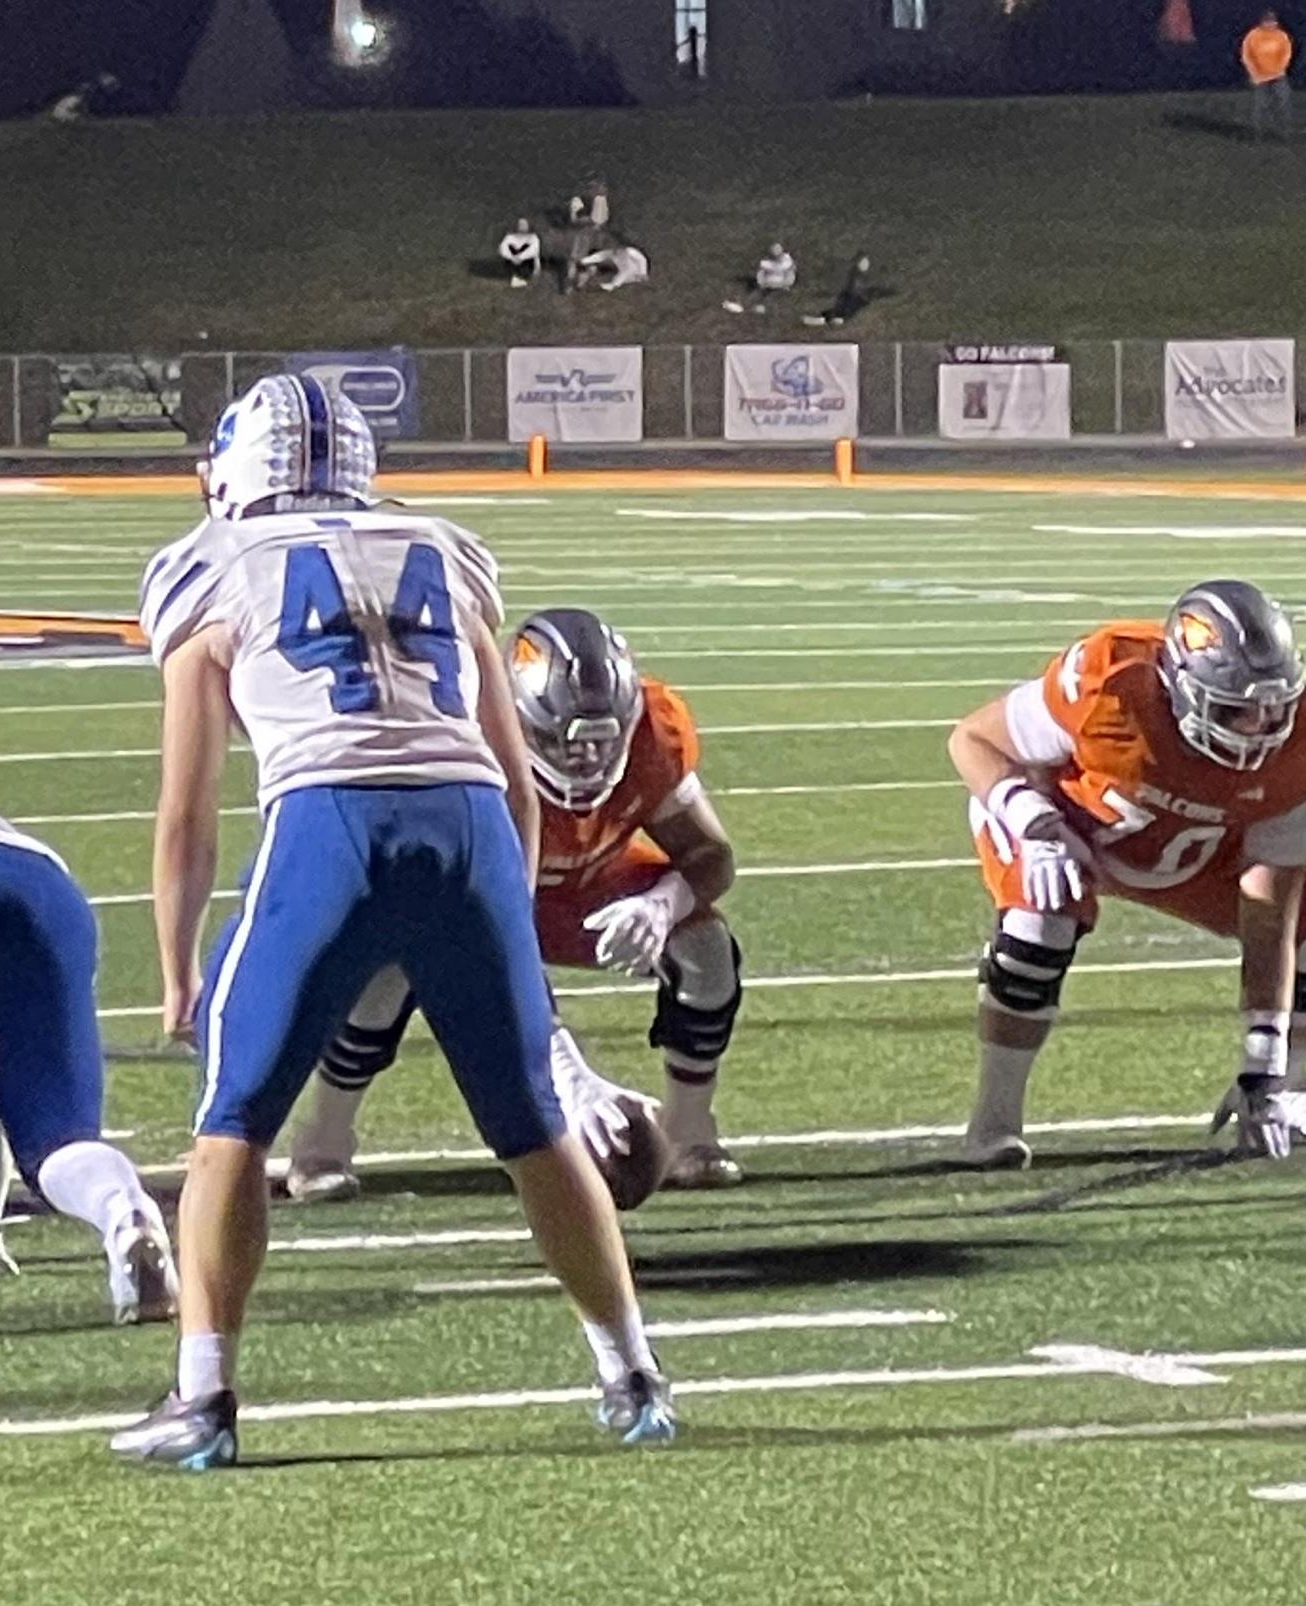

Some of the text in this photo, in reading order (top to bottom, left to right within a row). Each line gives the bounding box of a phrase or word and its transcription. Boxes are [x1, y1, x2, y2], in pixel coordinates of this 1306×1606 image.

[955, 346, 978, 360] GO
[1175, 376, 1286, 395] Advocates
[515, 389, 635, 404] AMERICA FIRST
[277, 541, 470, 719] 44
